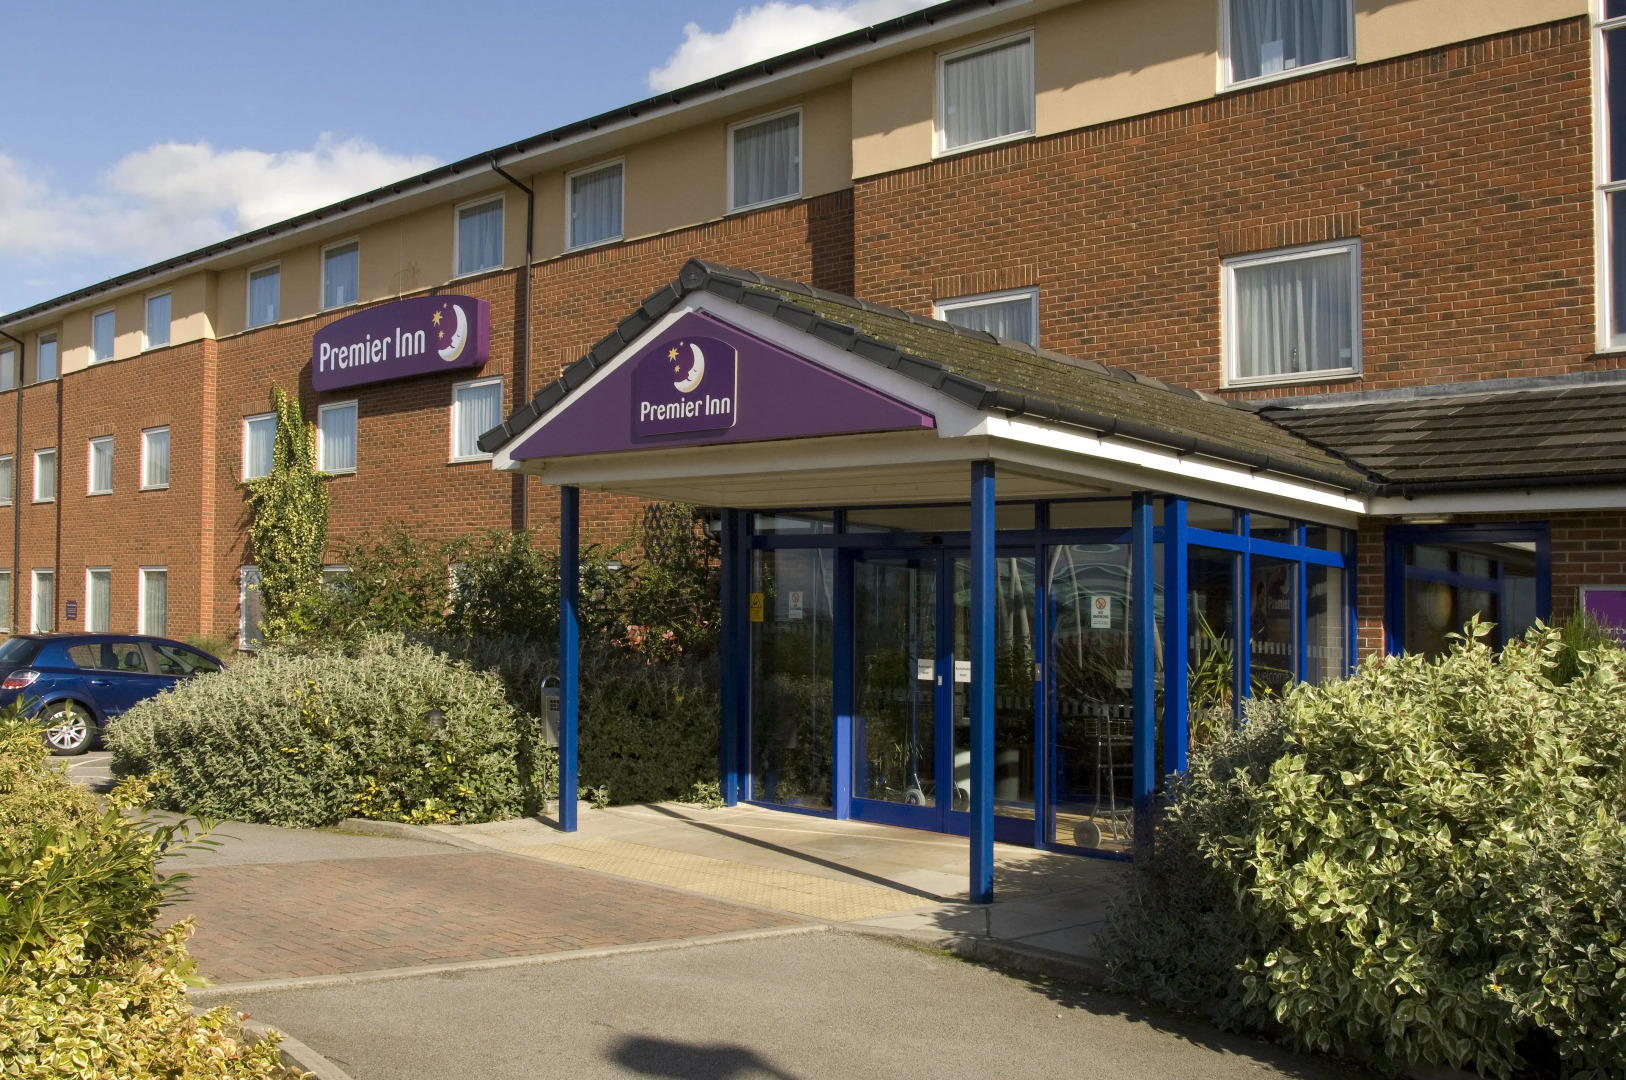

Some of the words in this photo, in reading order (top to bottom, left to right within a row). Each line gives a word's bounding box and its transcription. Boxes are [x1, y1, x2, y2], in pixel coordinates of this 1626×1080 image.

[319, 333, 391, 372] Premier
[395, 327, 426, 359] Inn
[640, 397, 702, 422] Premier
[705, 394, 731, 416] Inn
